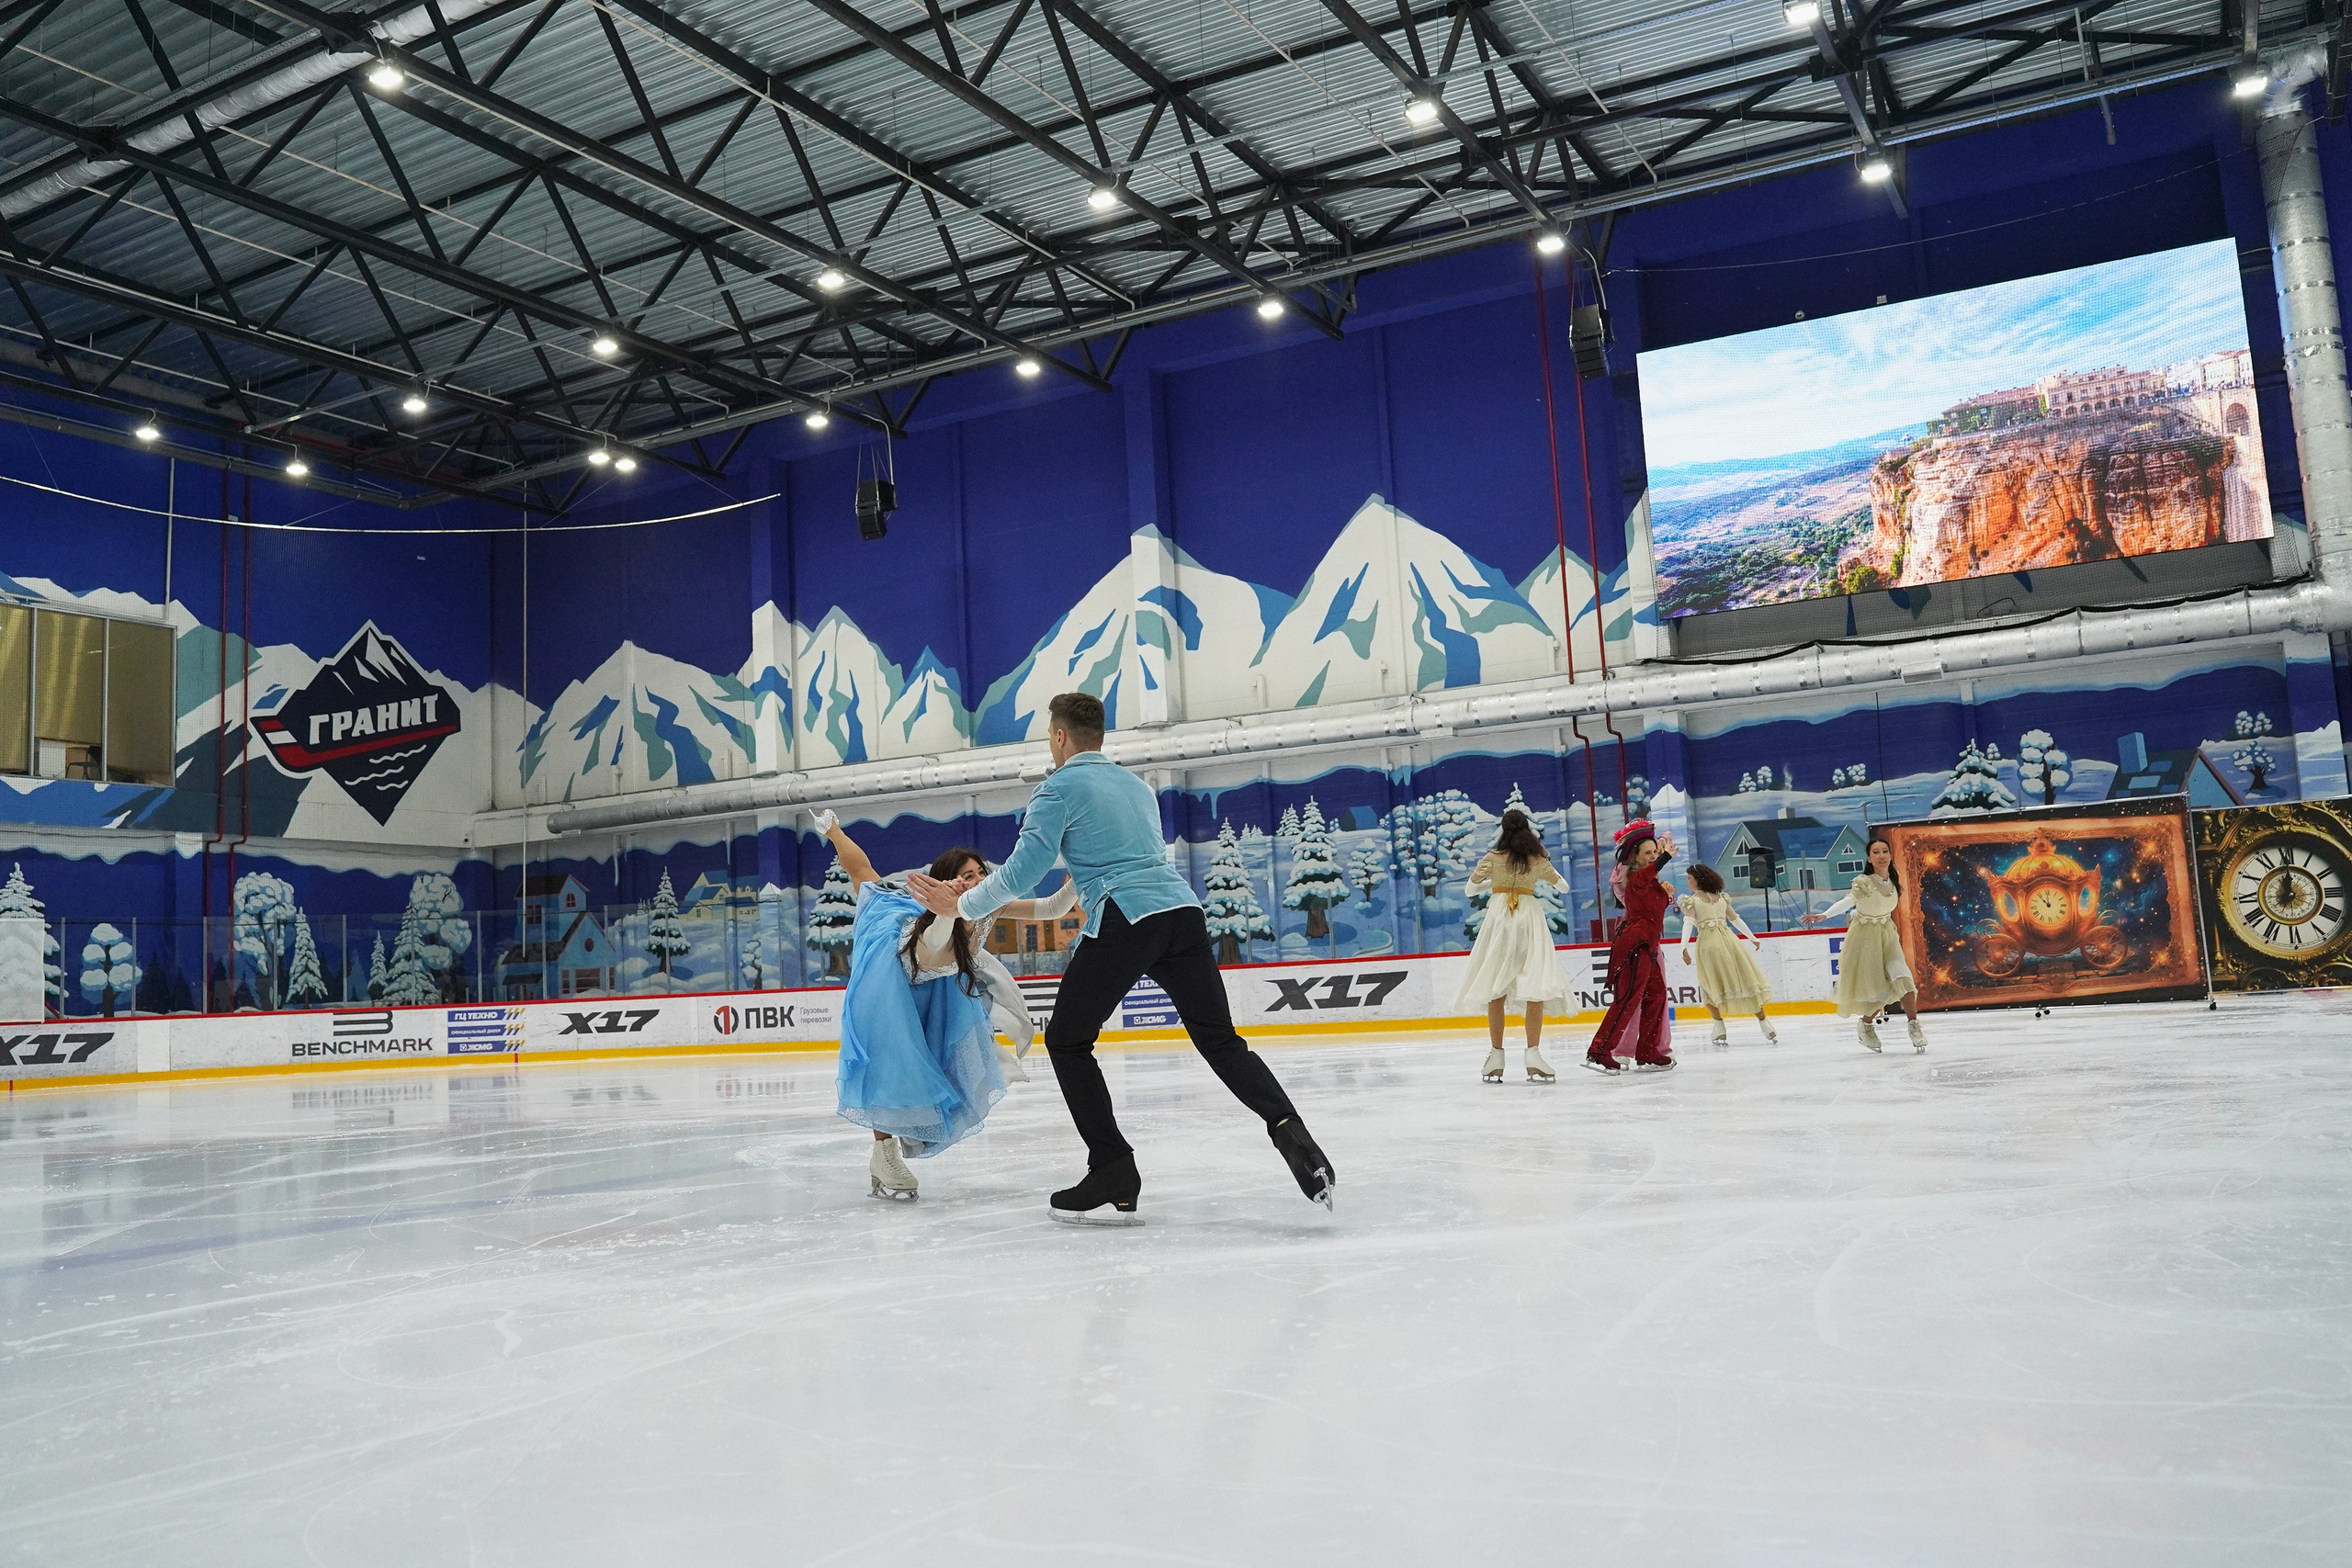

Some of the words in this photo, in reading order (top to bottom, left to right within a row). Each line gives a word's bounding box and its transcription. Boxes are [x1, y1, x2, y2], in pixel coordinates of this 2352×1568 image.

[309, 694, 438, 745] ГРАНИТ
[1262, 971, 1408, 1012] X17
[468, 1011, 498, 1020] ТЕХНО
[745, 1006, 796, 1029] ПВК
[800, 1007, 829, 1016] Грузовые
[800, 1016, 832, 1024] перевозки
[557, 1010, 661, 1035] X17
[291, 1037, 434, 1057] BENCHMARK
